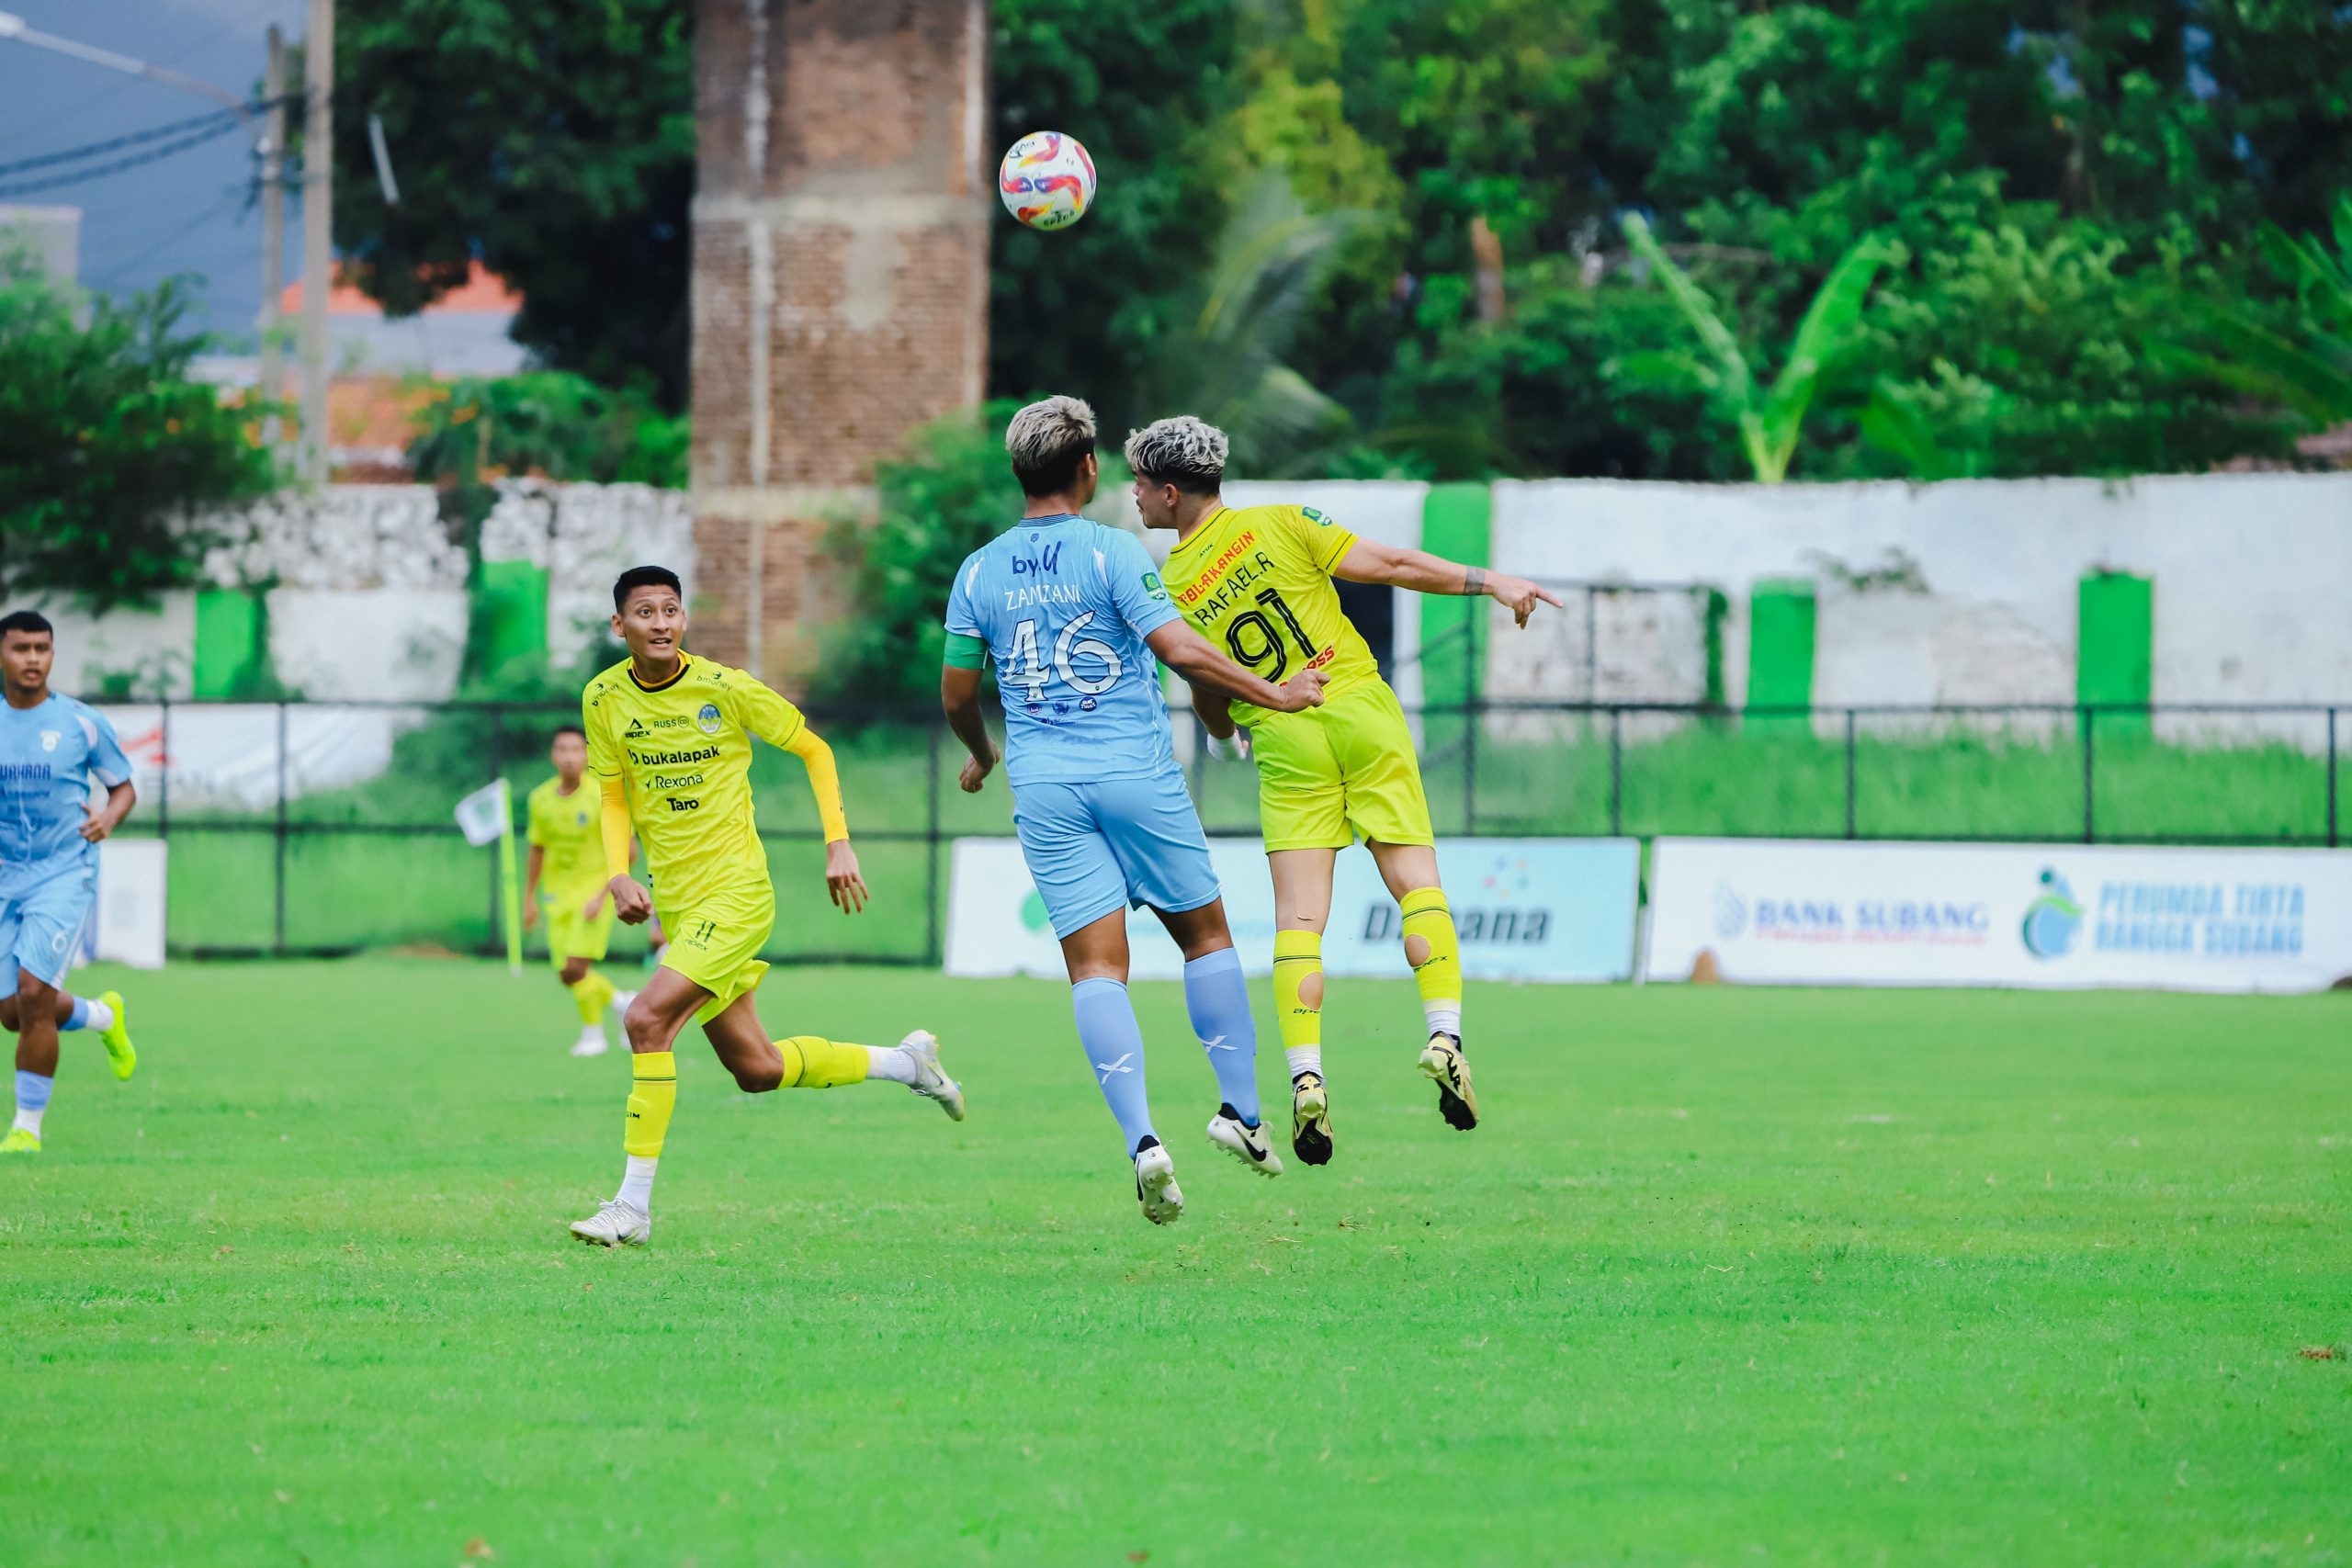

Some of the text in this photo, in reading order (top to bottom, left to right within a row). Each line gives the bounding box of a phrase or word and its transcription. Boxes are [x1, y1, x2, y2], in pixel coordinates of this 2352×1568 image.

[1004, 584, 1081, 612] ZAMZANI
[1194, 551, 1274, 626] RAFAEL.R
[1226, 588, 1317, 683] 91
[1001, 611, 1123, 702] 46
[625, 729, 651, 739] apex
[654, 719, 676, 728] RUSS
[641, 746, 719, 765] bukalapak
[655, 773, 703, 788] Rexona
[667, 797, 699, 811] Taro
[1362, 904, 1553, 943] Dana
[1756, 899, 1990, 931] BANK SUBANG
